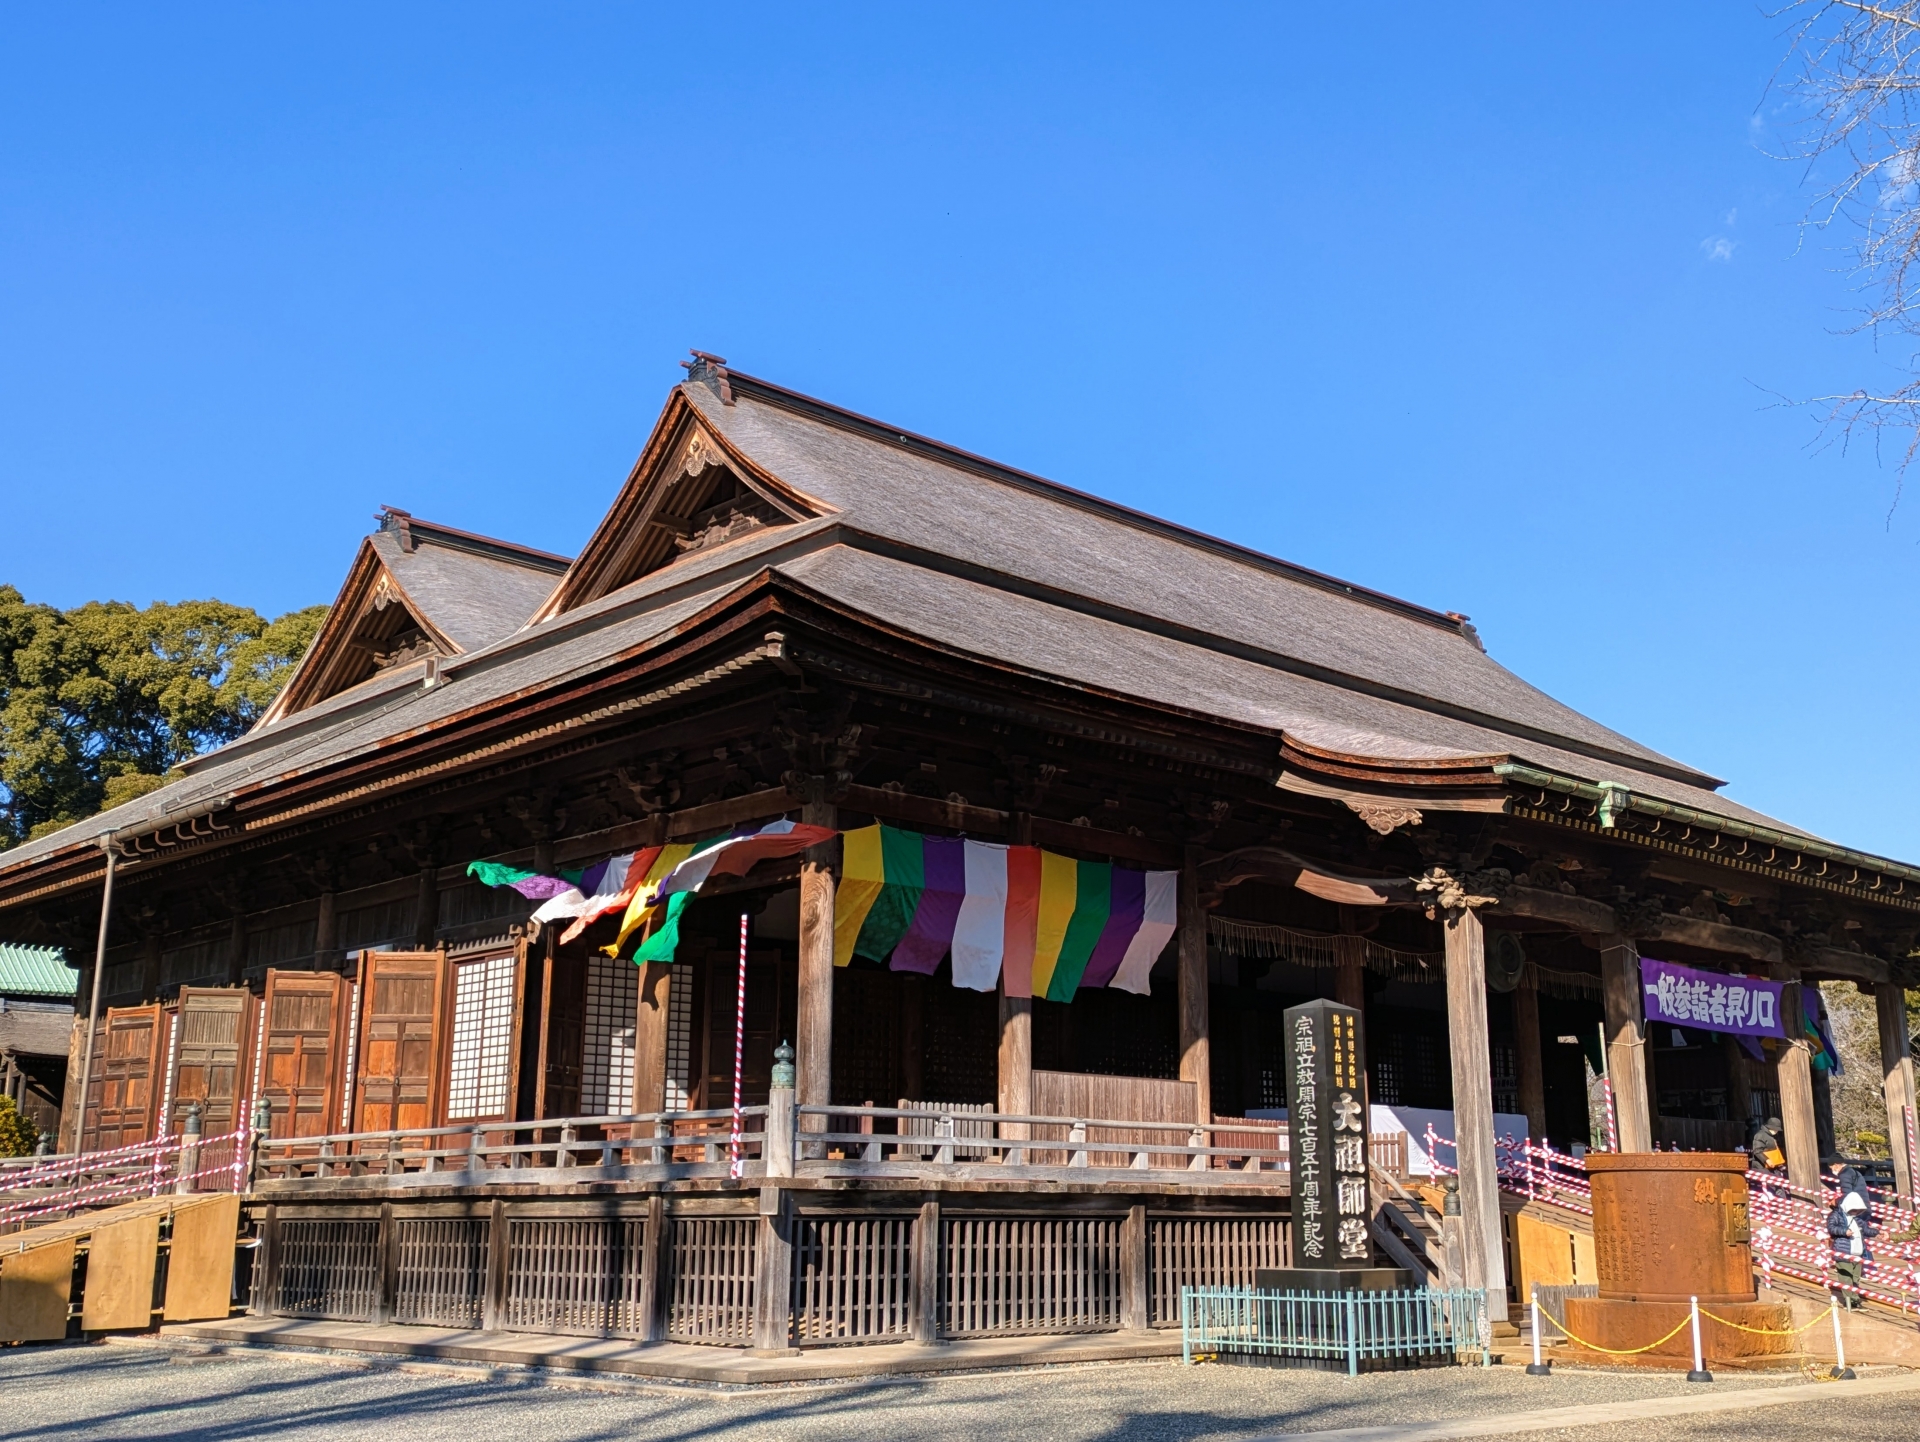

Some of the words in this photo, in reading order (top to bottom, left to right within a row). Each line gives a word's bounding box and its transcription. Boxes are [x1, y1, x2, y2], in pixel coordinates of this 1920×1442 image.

[1645, 971, 1775, 1029] 一般参詣者昇り口
[1294, 1015, 1325, 1259] 宗祖立教開宗七百五十周年記念
[1331, 1091, 1369, 1260] 大祖師堂
